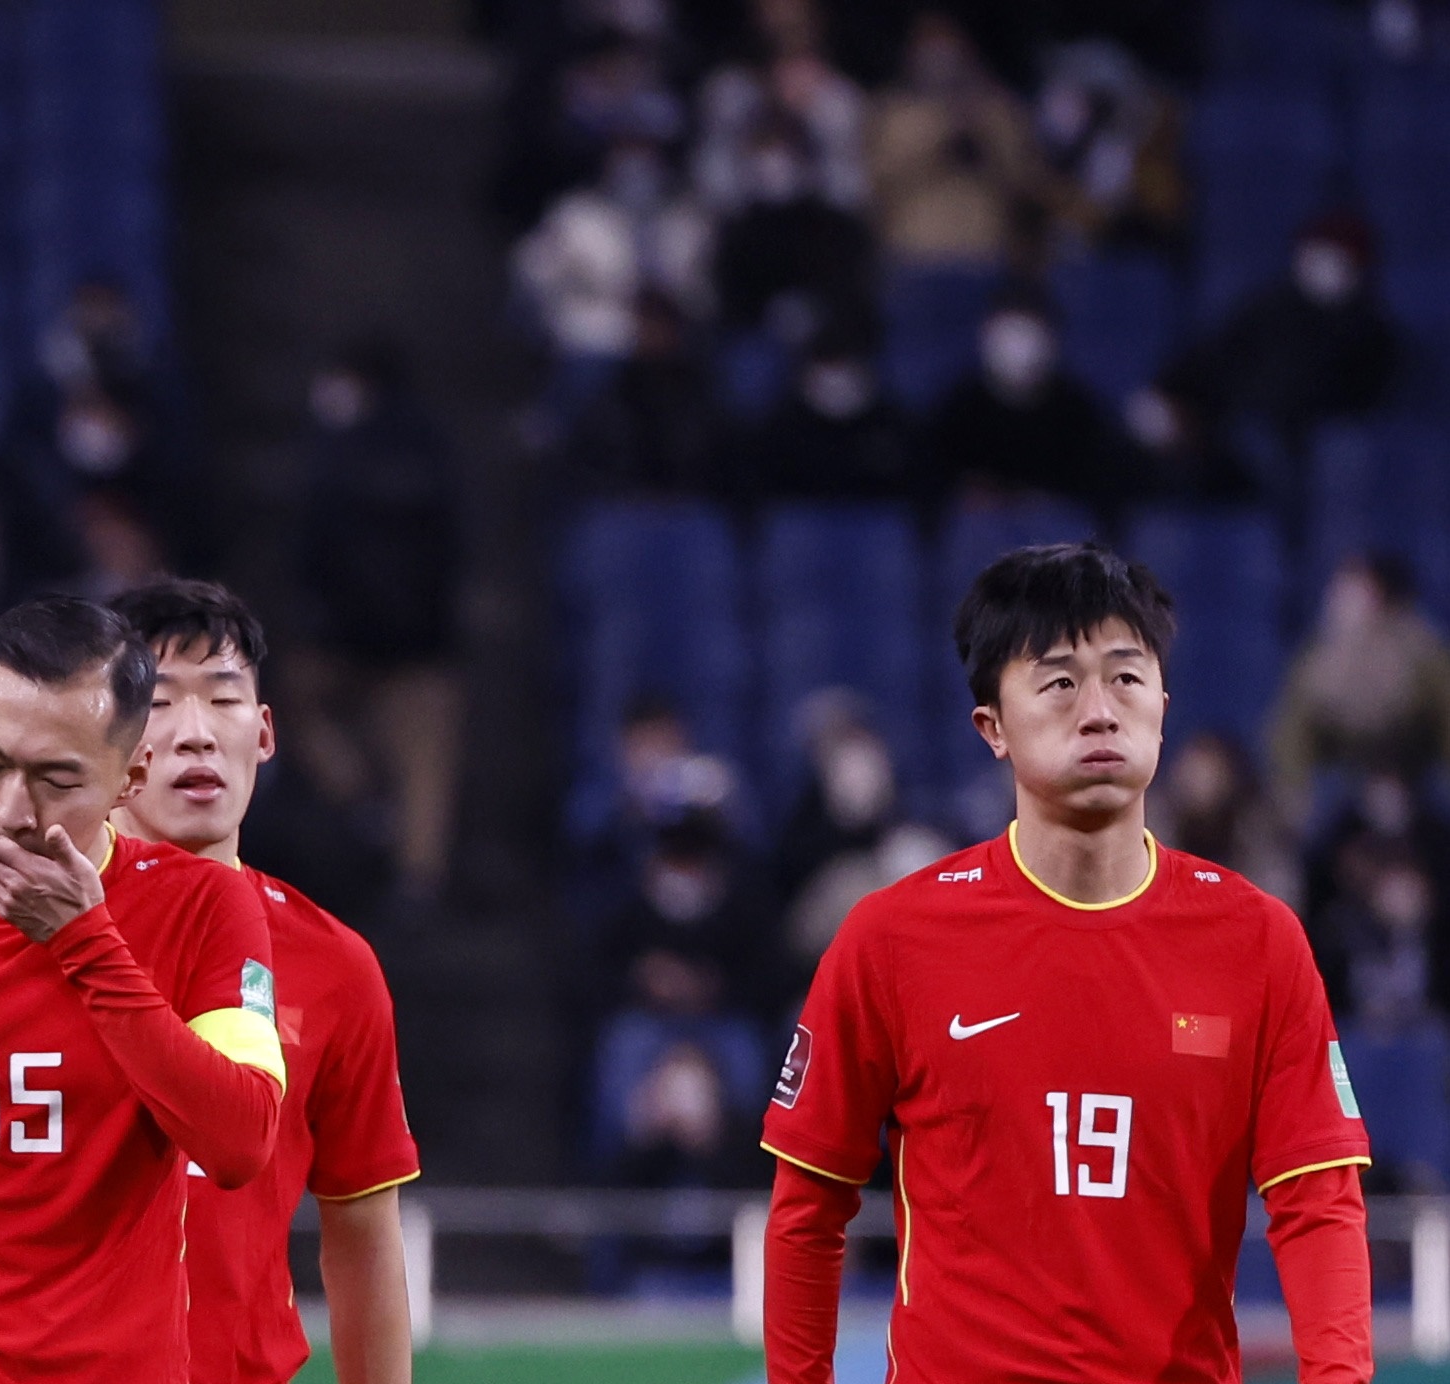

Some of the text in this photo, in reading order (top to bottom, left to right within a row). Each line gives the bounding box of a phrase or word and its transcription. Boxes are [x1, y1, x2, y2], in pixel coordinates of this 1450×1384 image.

[938, 867, 983, 883] CFA
[1194, 869, 1221, 883] 中国
[1045, 1091, 1133, 1199] 19
